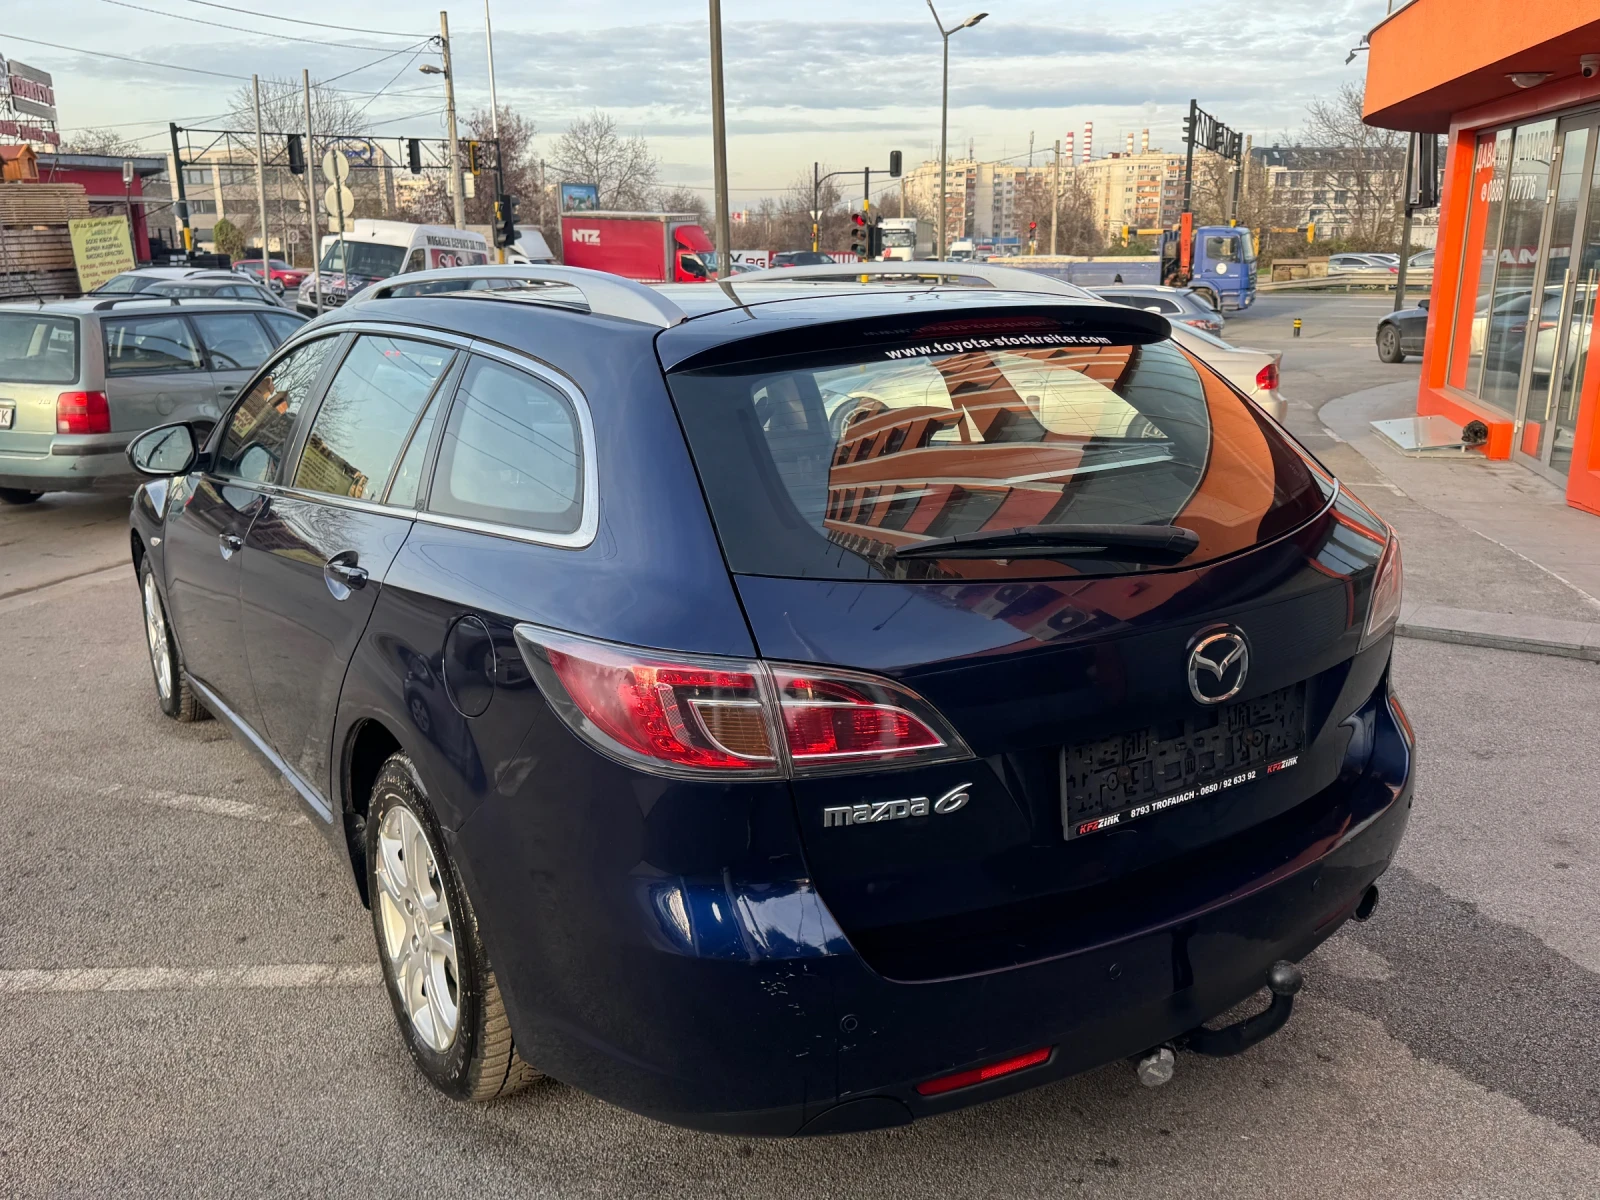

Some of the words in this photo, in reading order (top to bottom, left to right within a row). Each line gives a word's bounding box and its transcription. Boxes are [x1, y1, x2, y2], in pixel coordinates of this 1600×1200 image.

[572, 228, 600, 243] NTZ
[885, 334, 1112, 360] www.toyota-stockreiter.com
[934, 782, 973, 814] 6
[1130, 805, 1150, 818] 8793
[1152, 791, 1195, 811] TROFAIACH
[1200, 783, 1218, 796] 0650
[1223, 777, 1232, 789] 92
[1233, 774, 1246, 785] 633
[1247, 770, 1256, 780] 92
